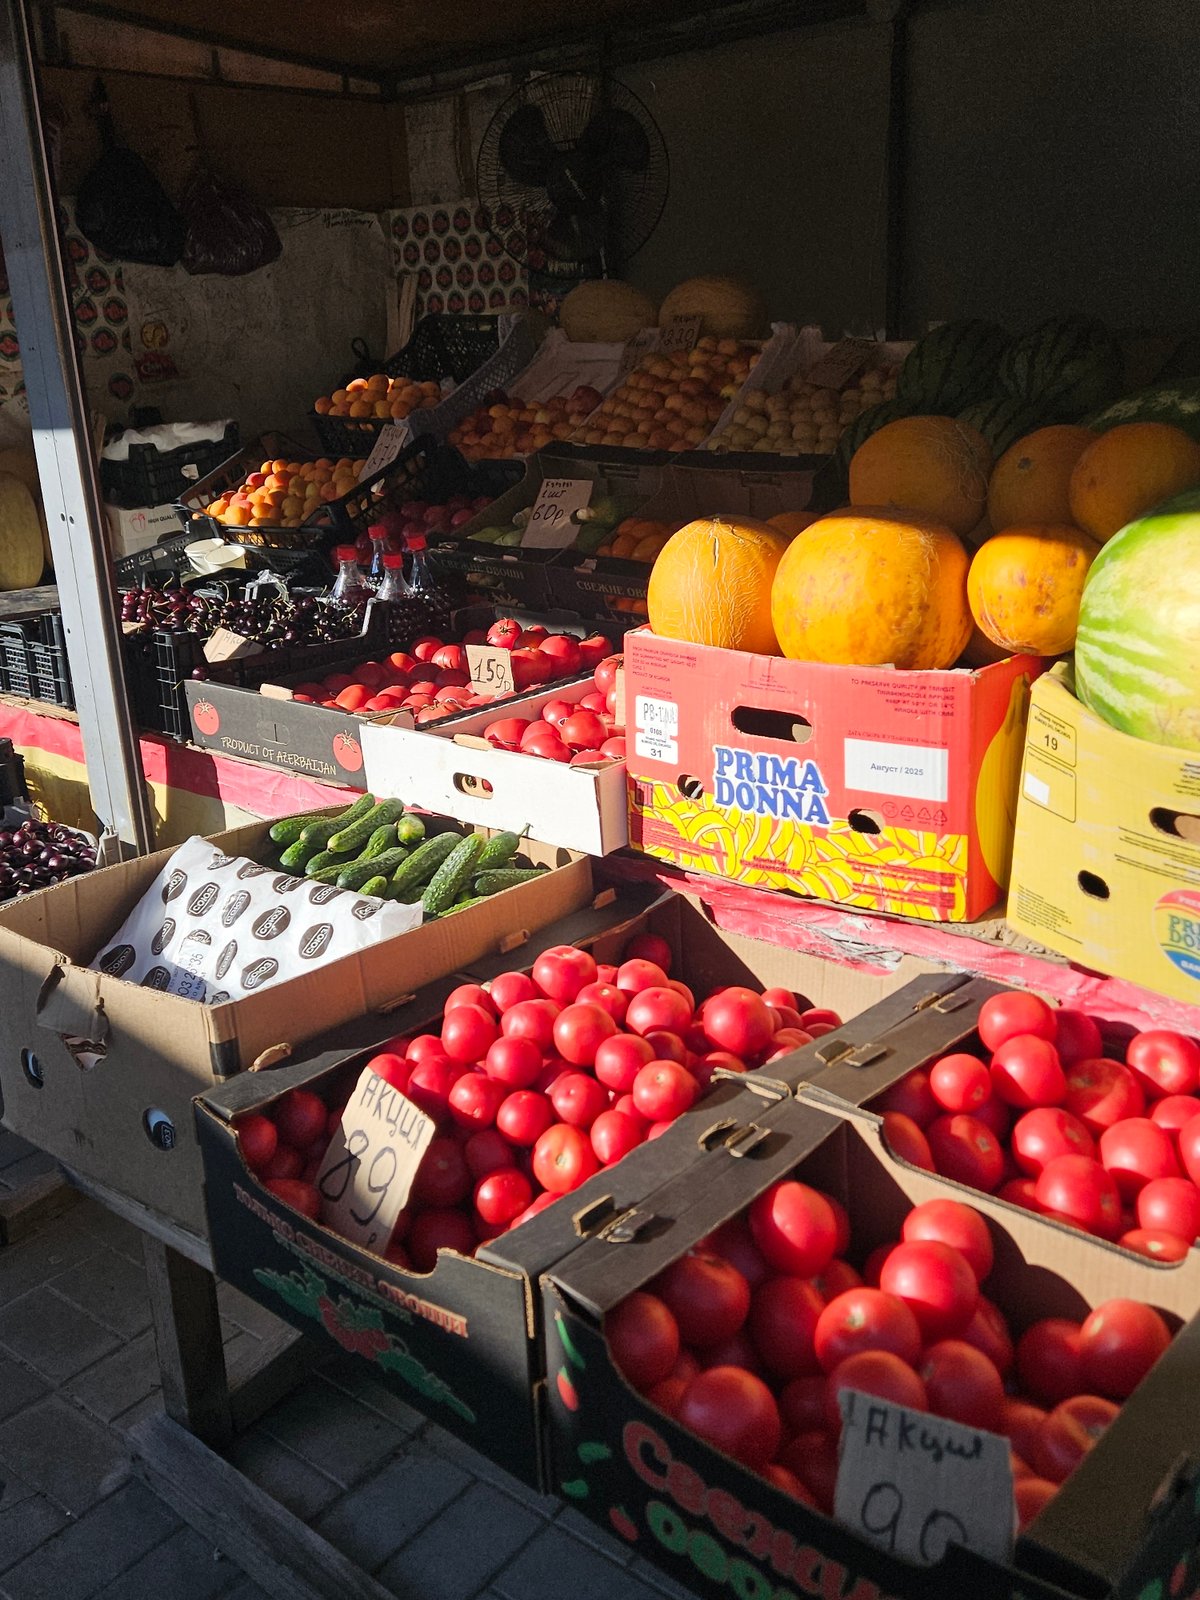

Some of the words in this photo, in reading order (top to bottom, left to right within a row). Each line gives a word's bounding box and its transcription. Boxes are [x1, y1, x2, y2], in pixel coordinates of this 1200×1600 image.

[220, 736, 260, 756] PRODUCT
[262, 747, 275, 761] OF
[276, 751, 337, 776] AZERBAIJAN
[650, 748, 662, 758] 31
[1044, 734, 1058, 751] 19
[714, 746, 826, 794] PRIMA
[870, 762, 898, 776] Август
[904, 766, 924, 776] 2025
[715, 776, 830, 825] DONNA
[318, 1129, 397, 1227] 89
